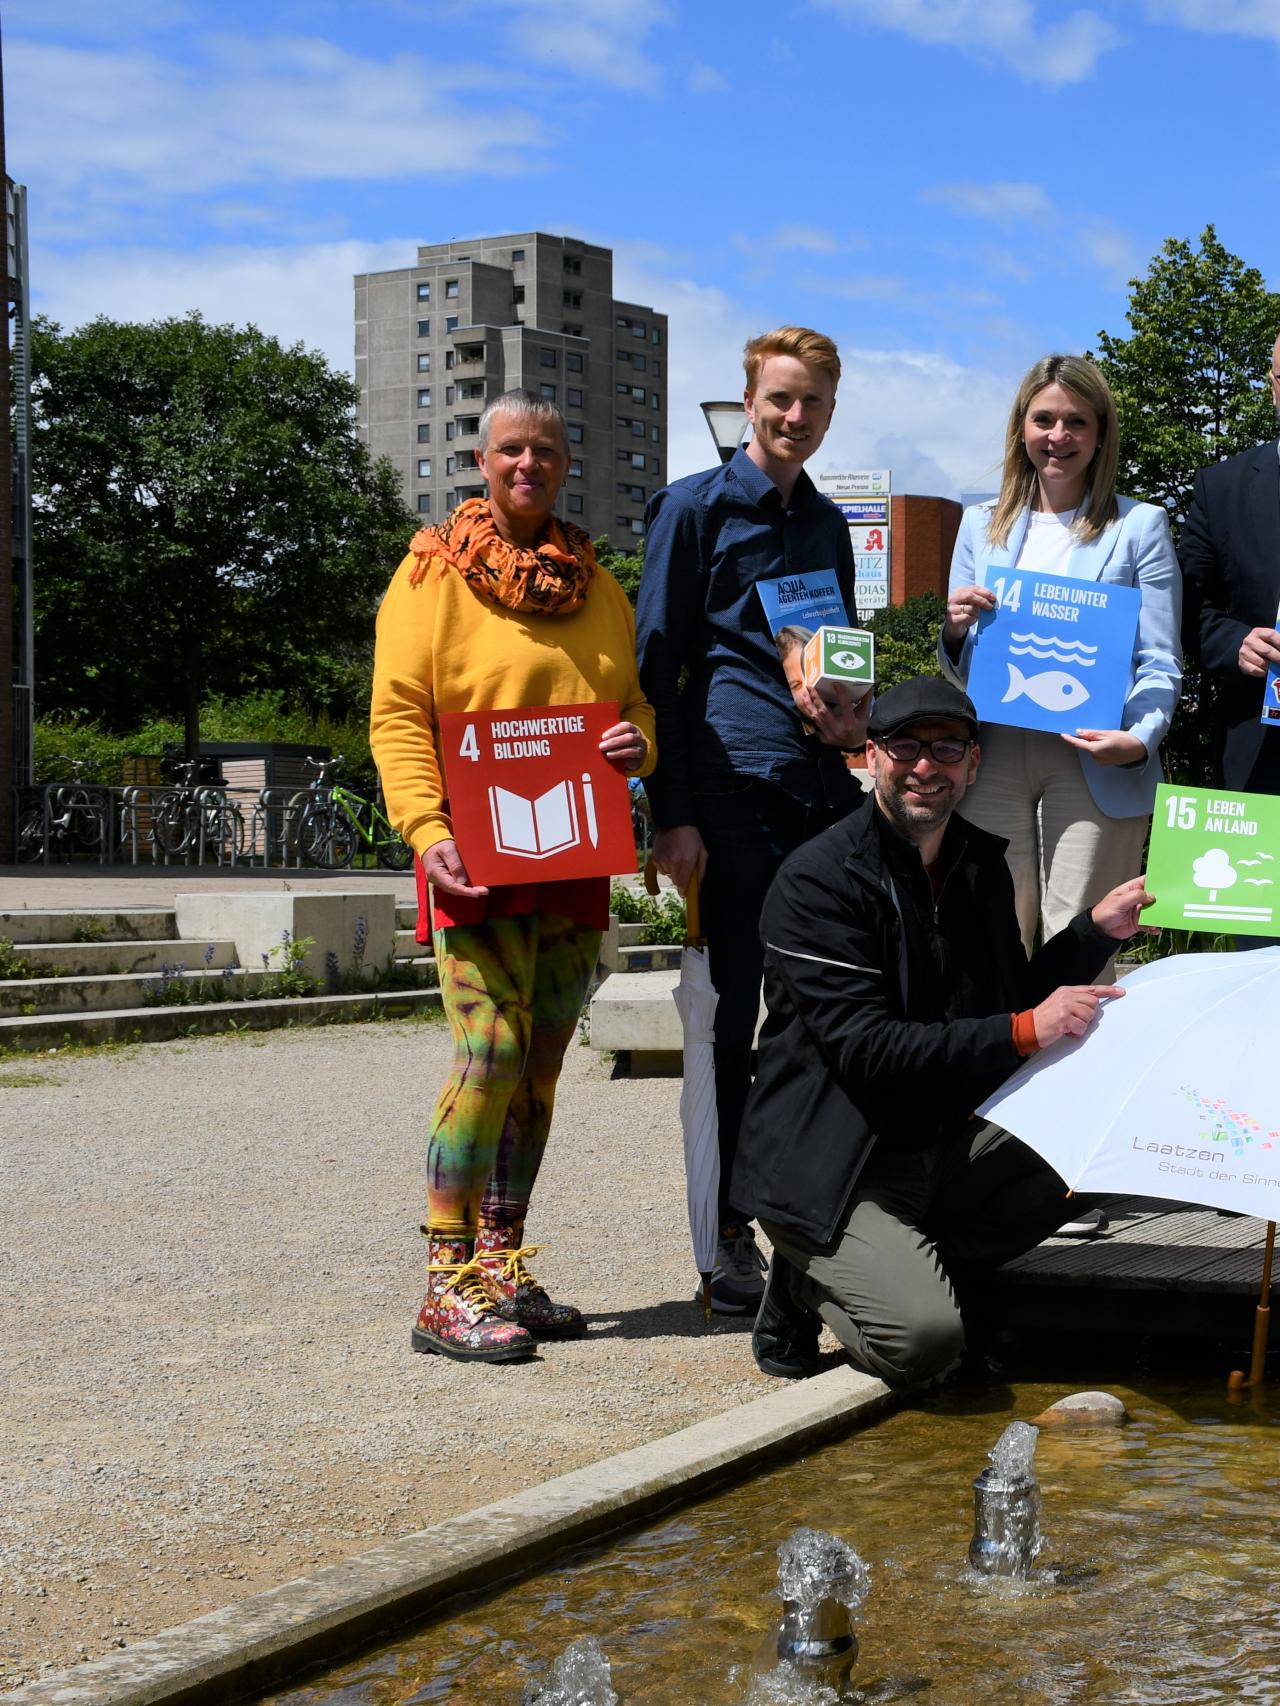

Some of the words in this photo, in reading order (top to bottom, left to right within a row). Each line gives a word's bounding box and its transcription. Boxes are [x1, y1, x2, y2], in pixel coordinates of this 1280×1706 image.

[842, 505, 886, 513] SPIELHALLE
[778, 579, 806, 596] AQUA
[994, 577, 1022, 613] 14
[1034, 582, 1070, 602] LEBEN
[1070, 588, 1108, 608] UNTER
[1032, 601, 1080, 623] WASSER
[826, 632, 836, 644] 13
[491, 716, 585, 738] HOCHWERTIGE
[459, 724, 480, 762] 4
[494, 740, 550, 760] BILDUNG
[1165, 796, 1198, 830] 15
[1206, 799, 1246, 817] LEBEN
[1204, 817, 1223, 832] AN
[1224, 820, 1258, 836] LAND
[1132, 1136, 1224, 1164] Laatzen
[1158, 1161, 1204, 1178] Stadt
[1209, 1169, 1237, 1182] der
